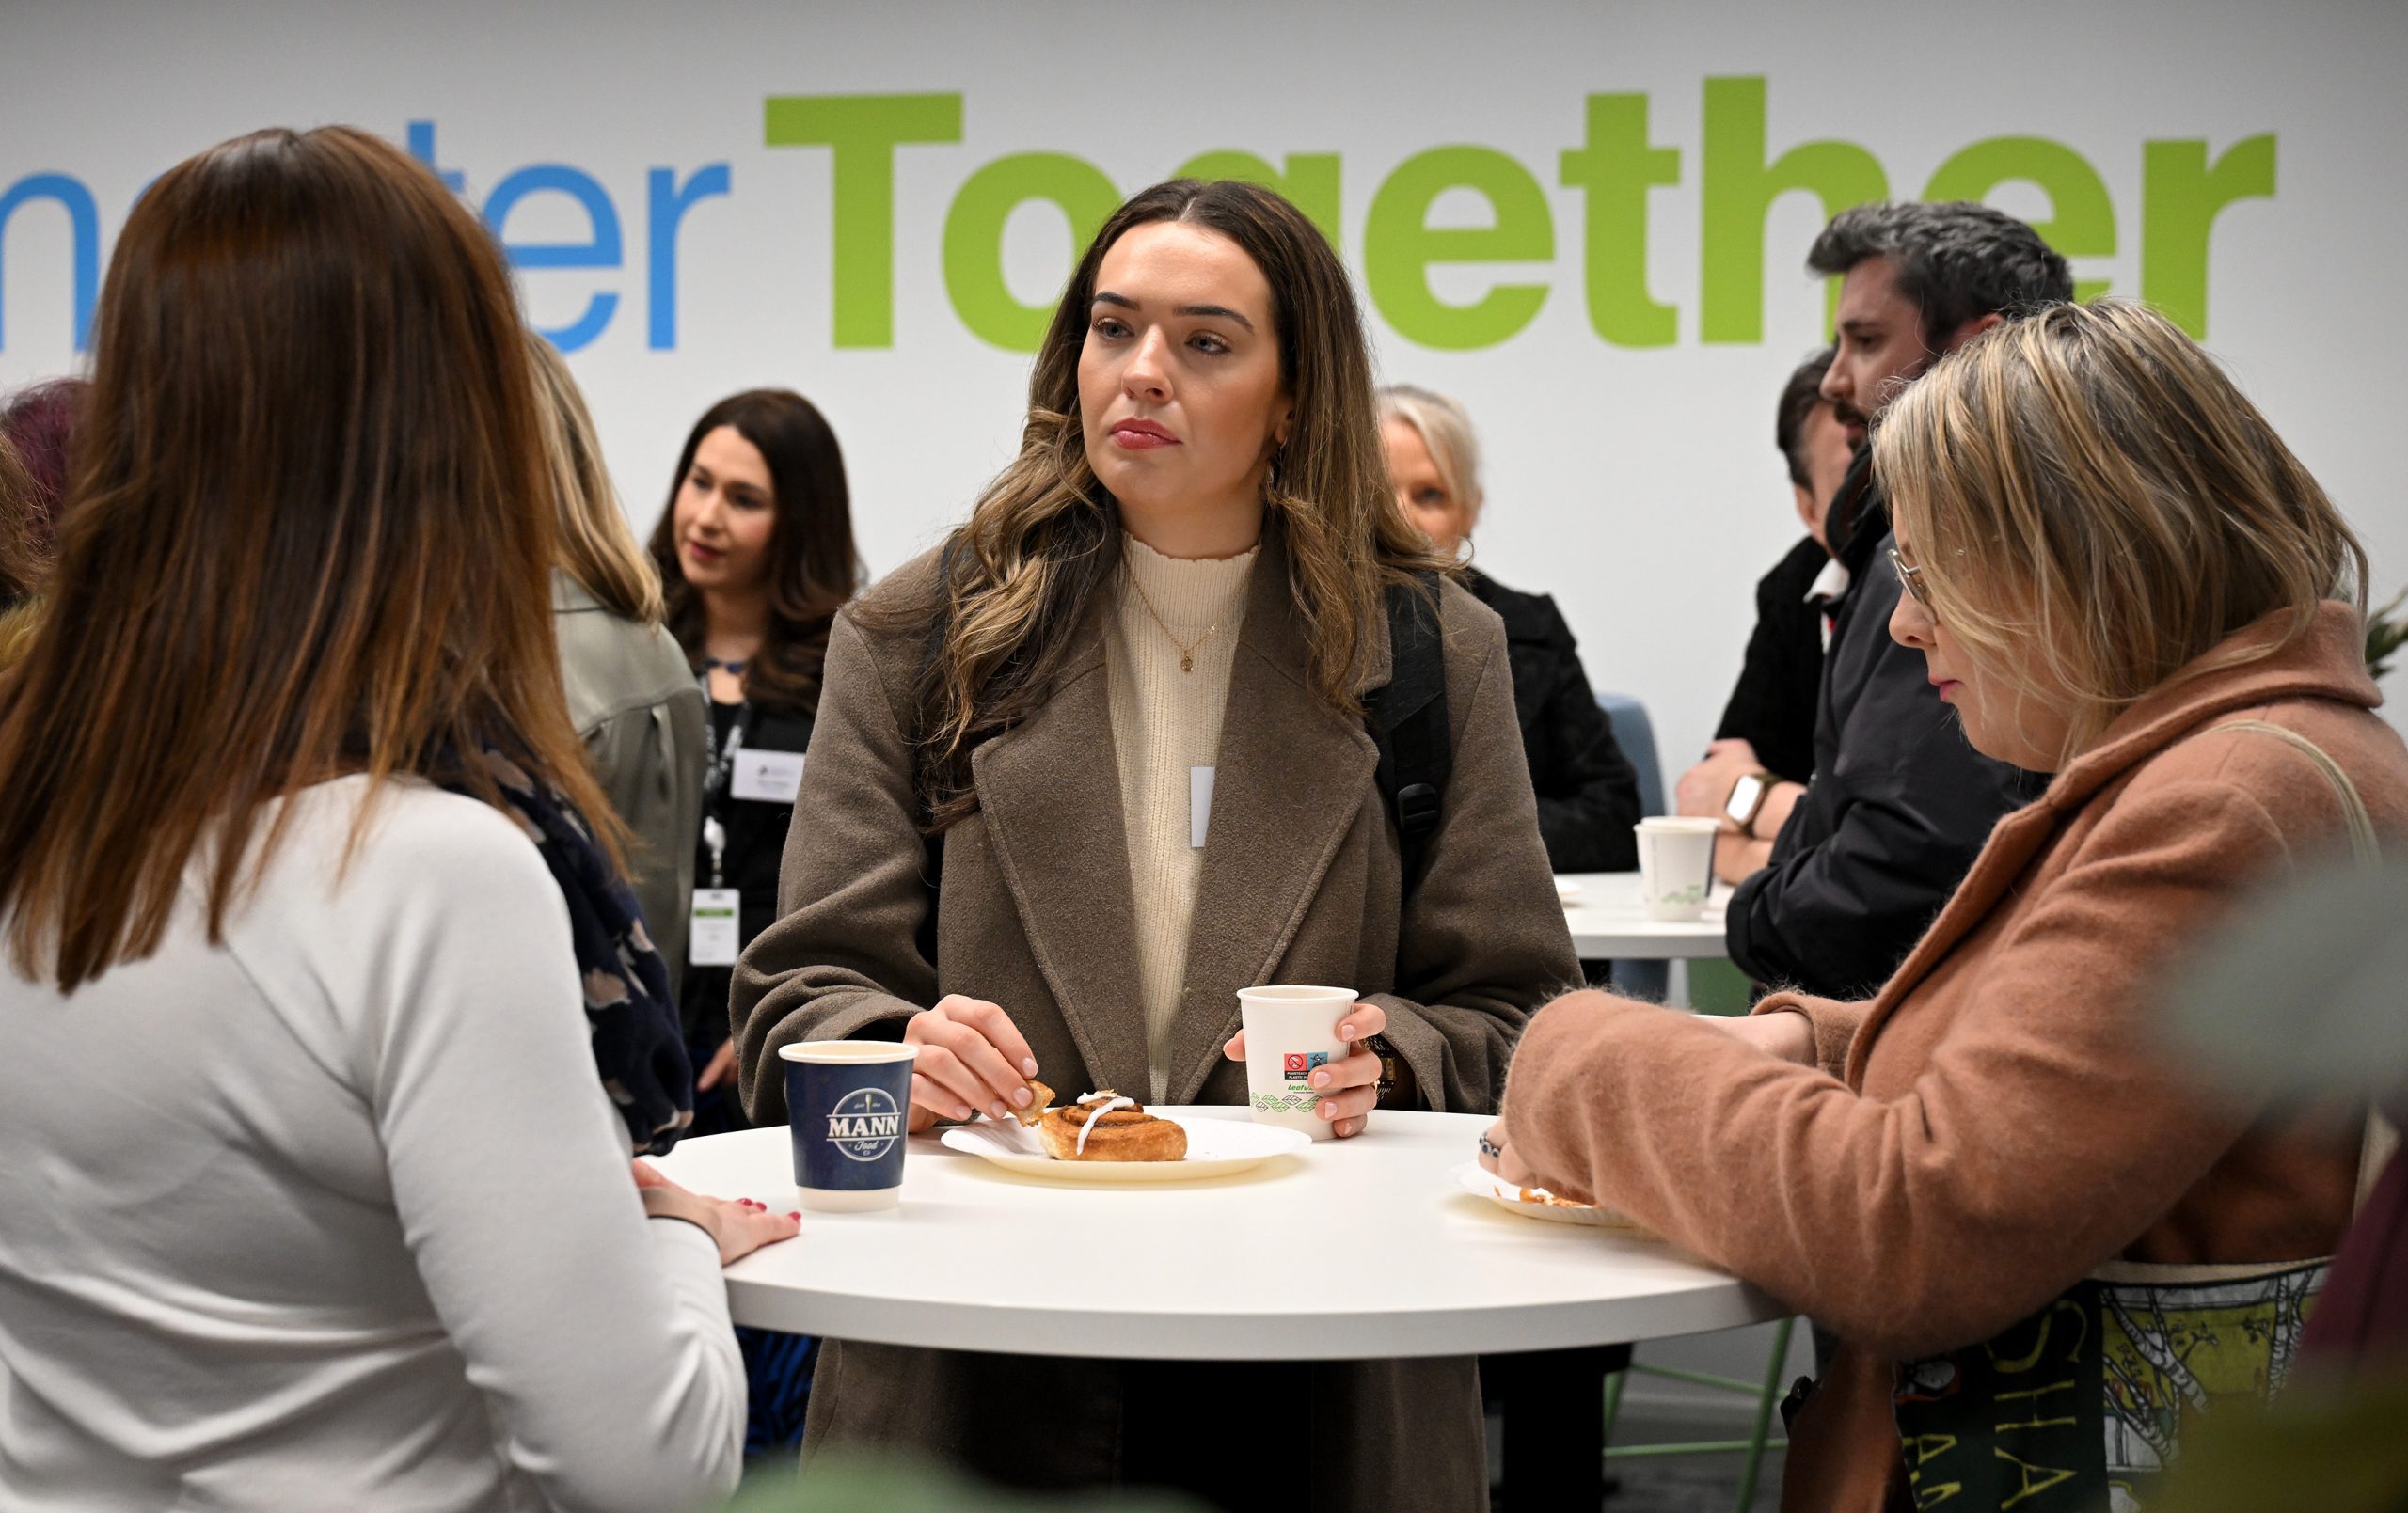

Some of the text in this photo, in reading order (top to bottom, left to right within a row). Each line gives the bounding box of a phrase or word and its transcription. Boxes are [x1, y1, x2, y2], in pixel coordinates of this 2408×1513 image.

[764, 75, 2278, 354] Toether
[828, 1115, 899, 1138] MANN
[854, 1140, 879, 1151] Food
